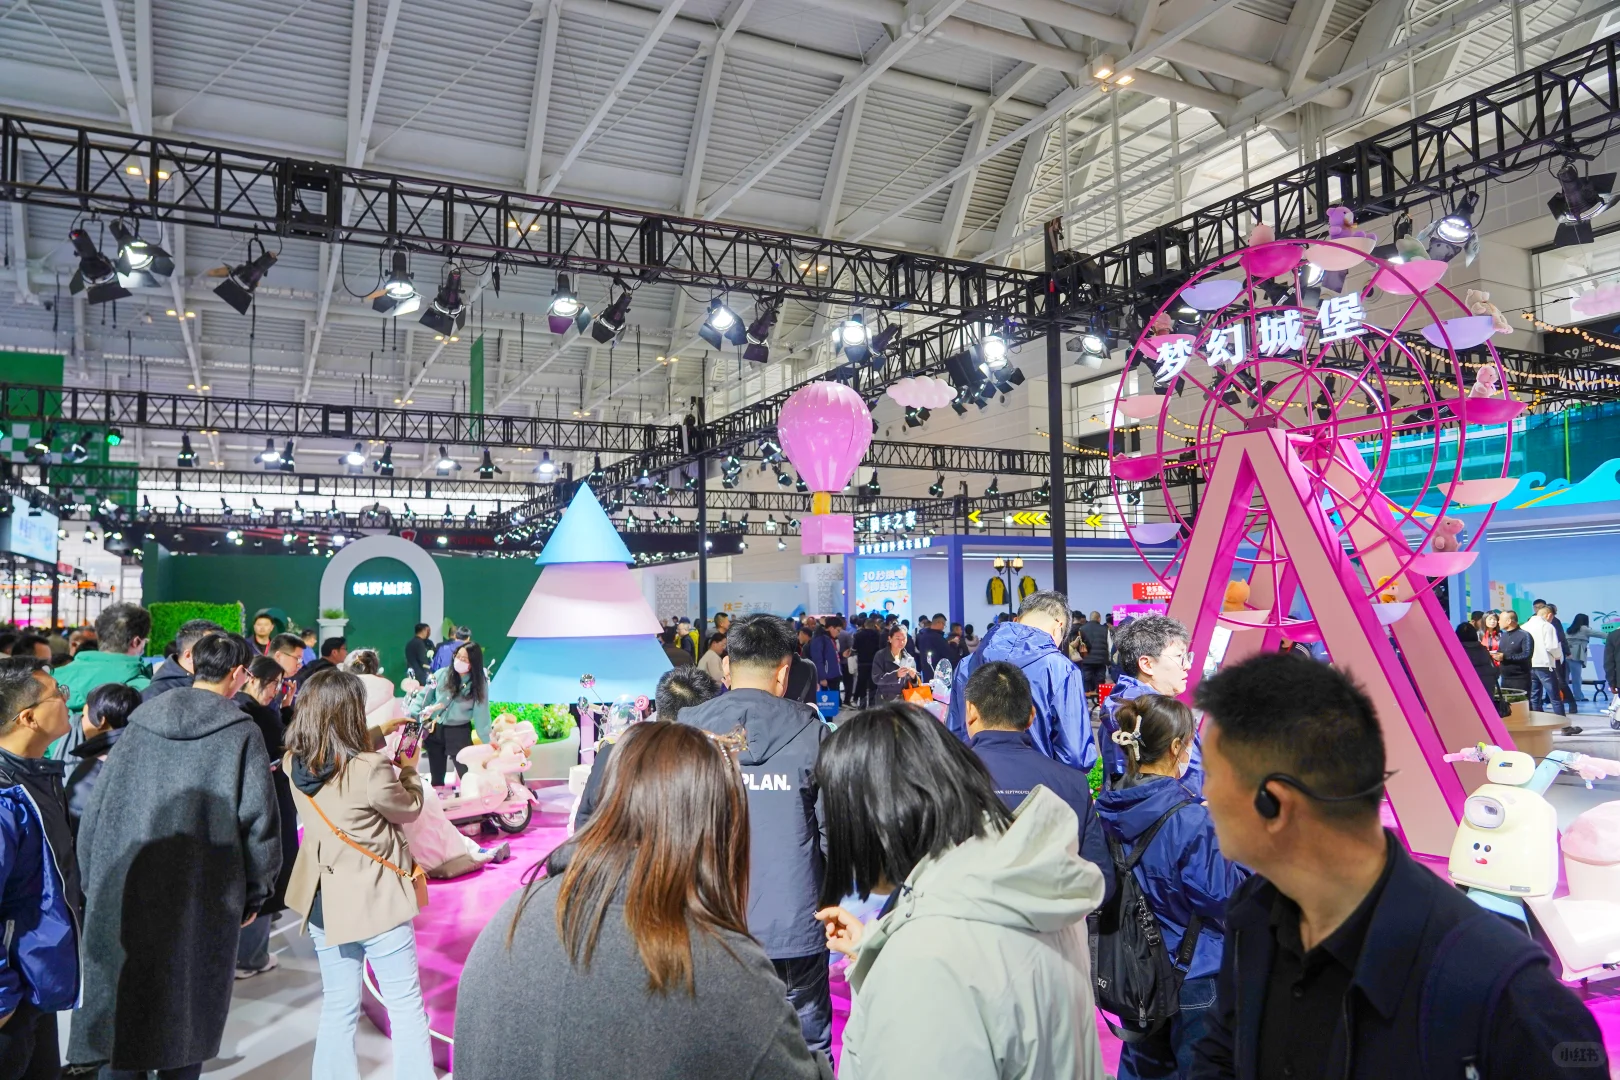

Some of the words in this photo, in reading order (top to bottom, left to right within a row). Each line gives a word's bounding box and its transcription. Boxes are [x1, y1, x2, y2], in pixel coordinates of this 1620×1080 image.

[1155, 292, 1366, 383] 梦幻城堡
[870, 510, 916, 533] 骑手之家
[741, 773, 791, 791] PLAN.
